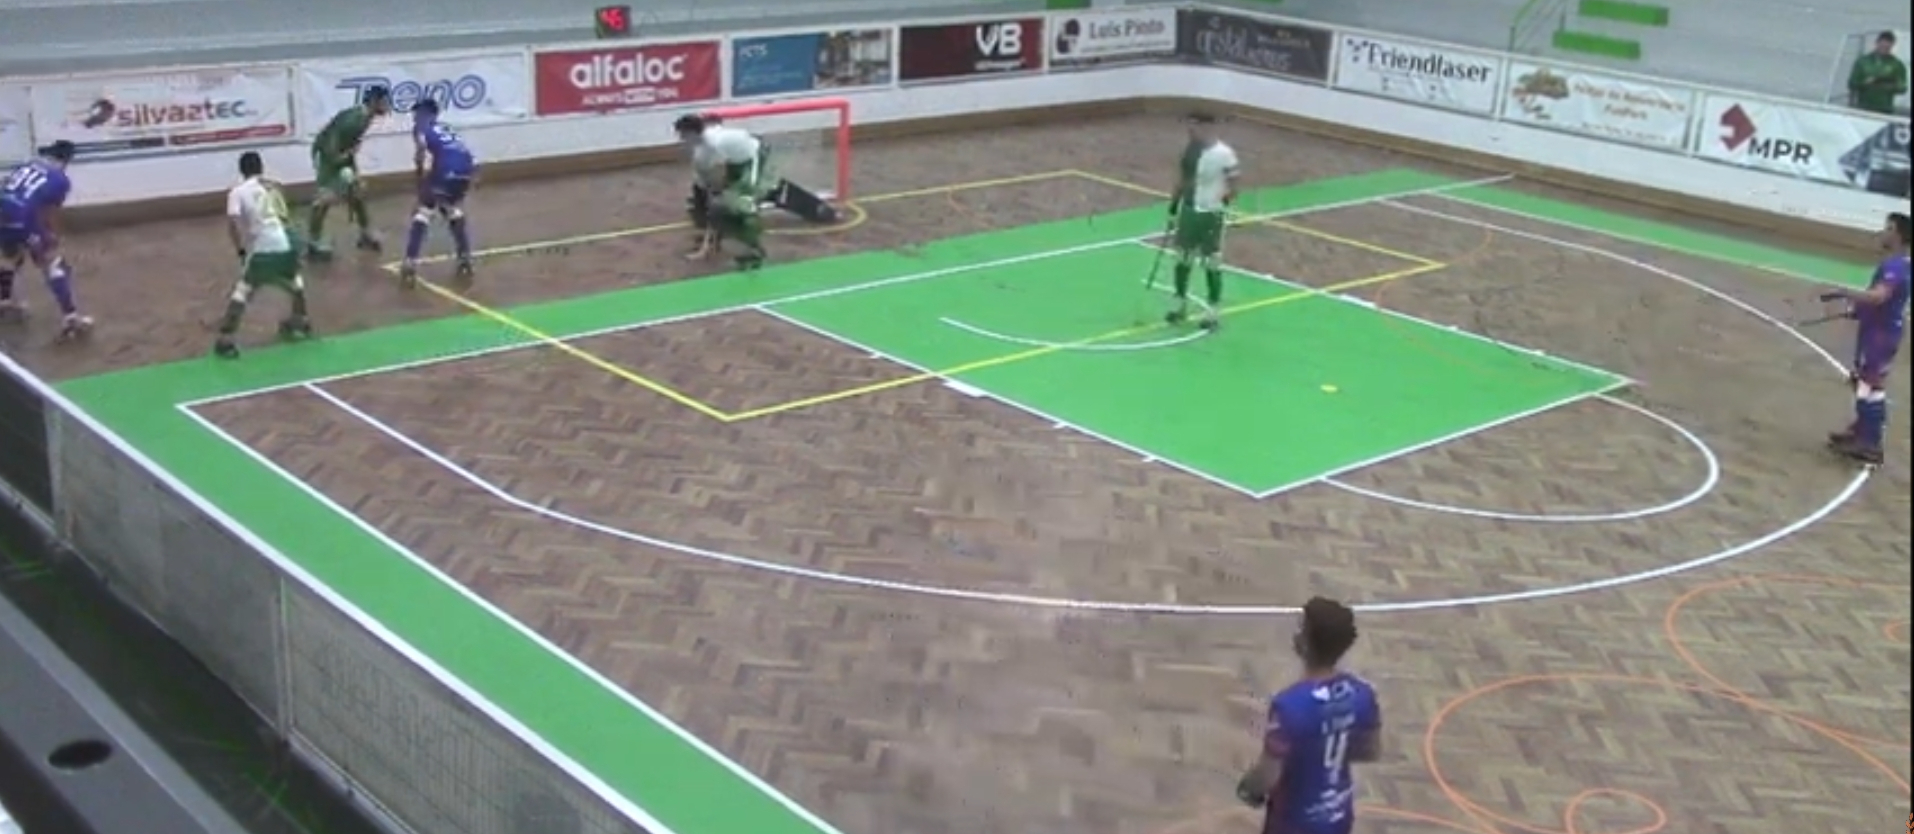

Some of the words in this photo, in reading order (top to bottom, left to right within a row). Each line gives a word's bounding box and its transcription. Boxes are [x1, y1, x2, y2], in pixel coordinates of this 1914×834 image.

[976, 22, 1022, 56] VB
[570, 53, 685, 89] alfaloc
[1368, 42, 1493, 83] Friendlaser
[1748, 138, 1813, 165] MPR
